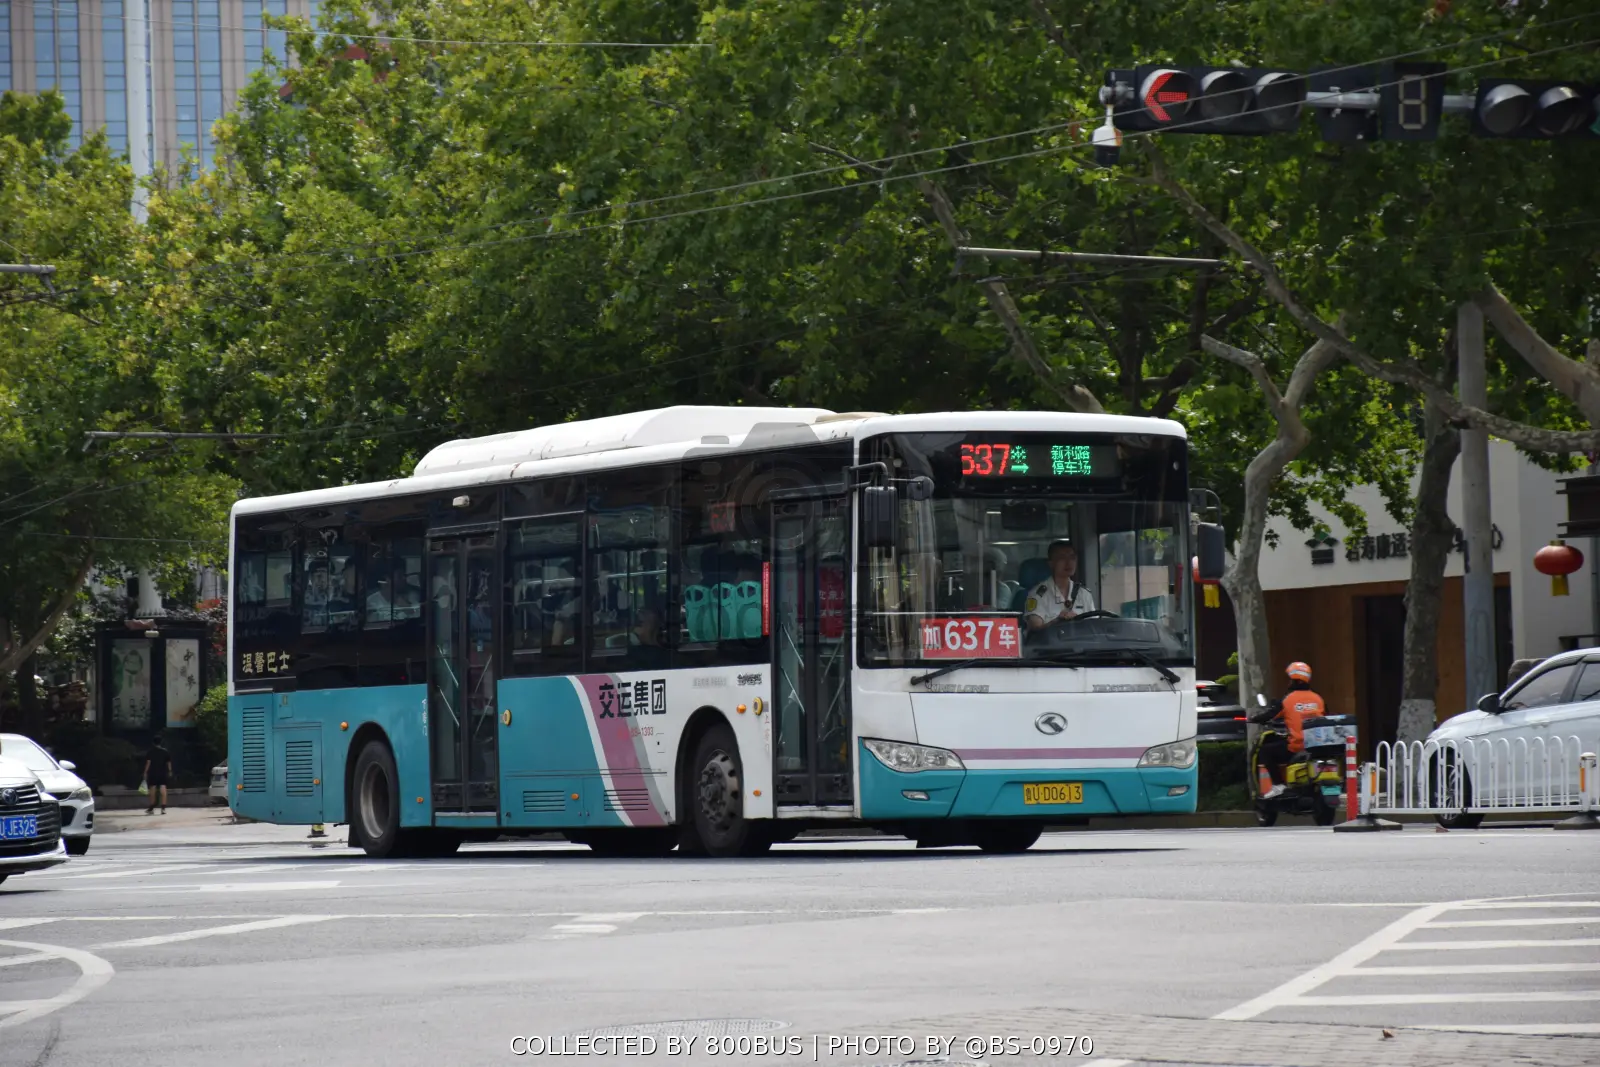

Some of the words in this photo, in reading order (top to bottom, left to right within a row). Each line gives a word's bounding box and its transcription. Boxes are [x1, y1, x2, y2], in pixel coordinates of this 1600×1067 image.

[1051, 445, 1090, 460] 新利路
[1052, 460, 1091, 475] 停车场
[242, 650, 291, 674] 温馨巴士
[598, 678, 667, 719] 交运集团
